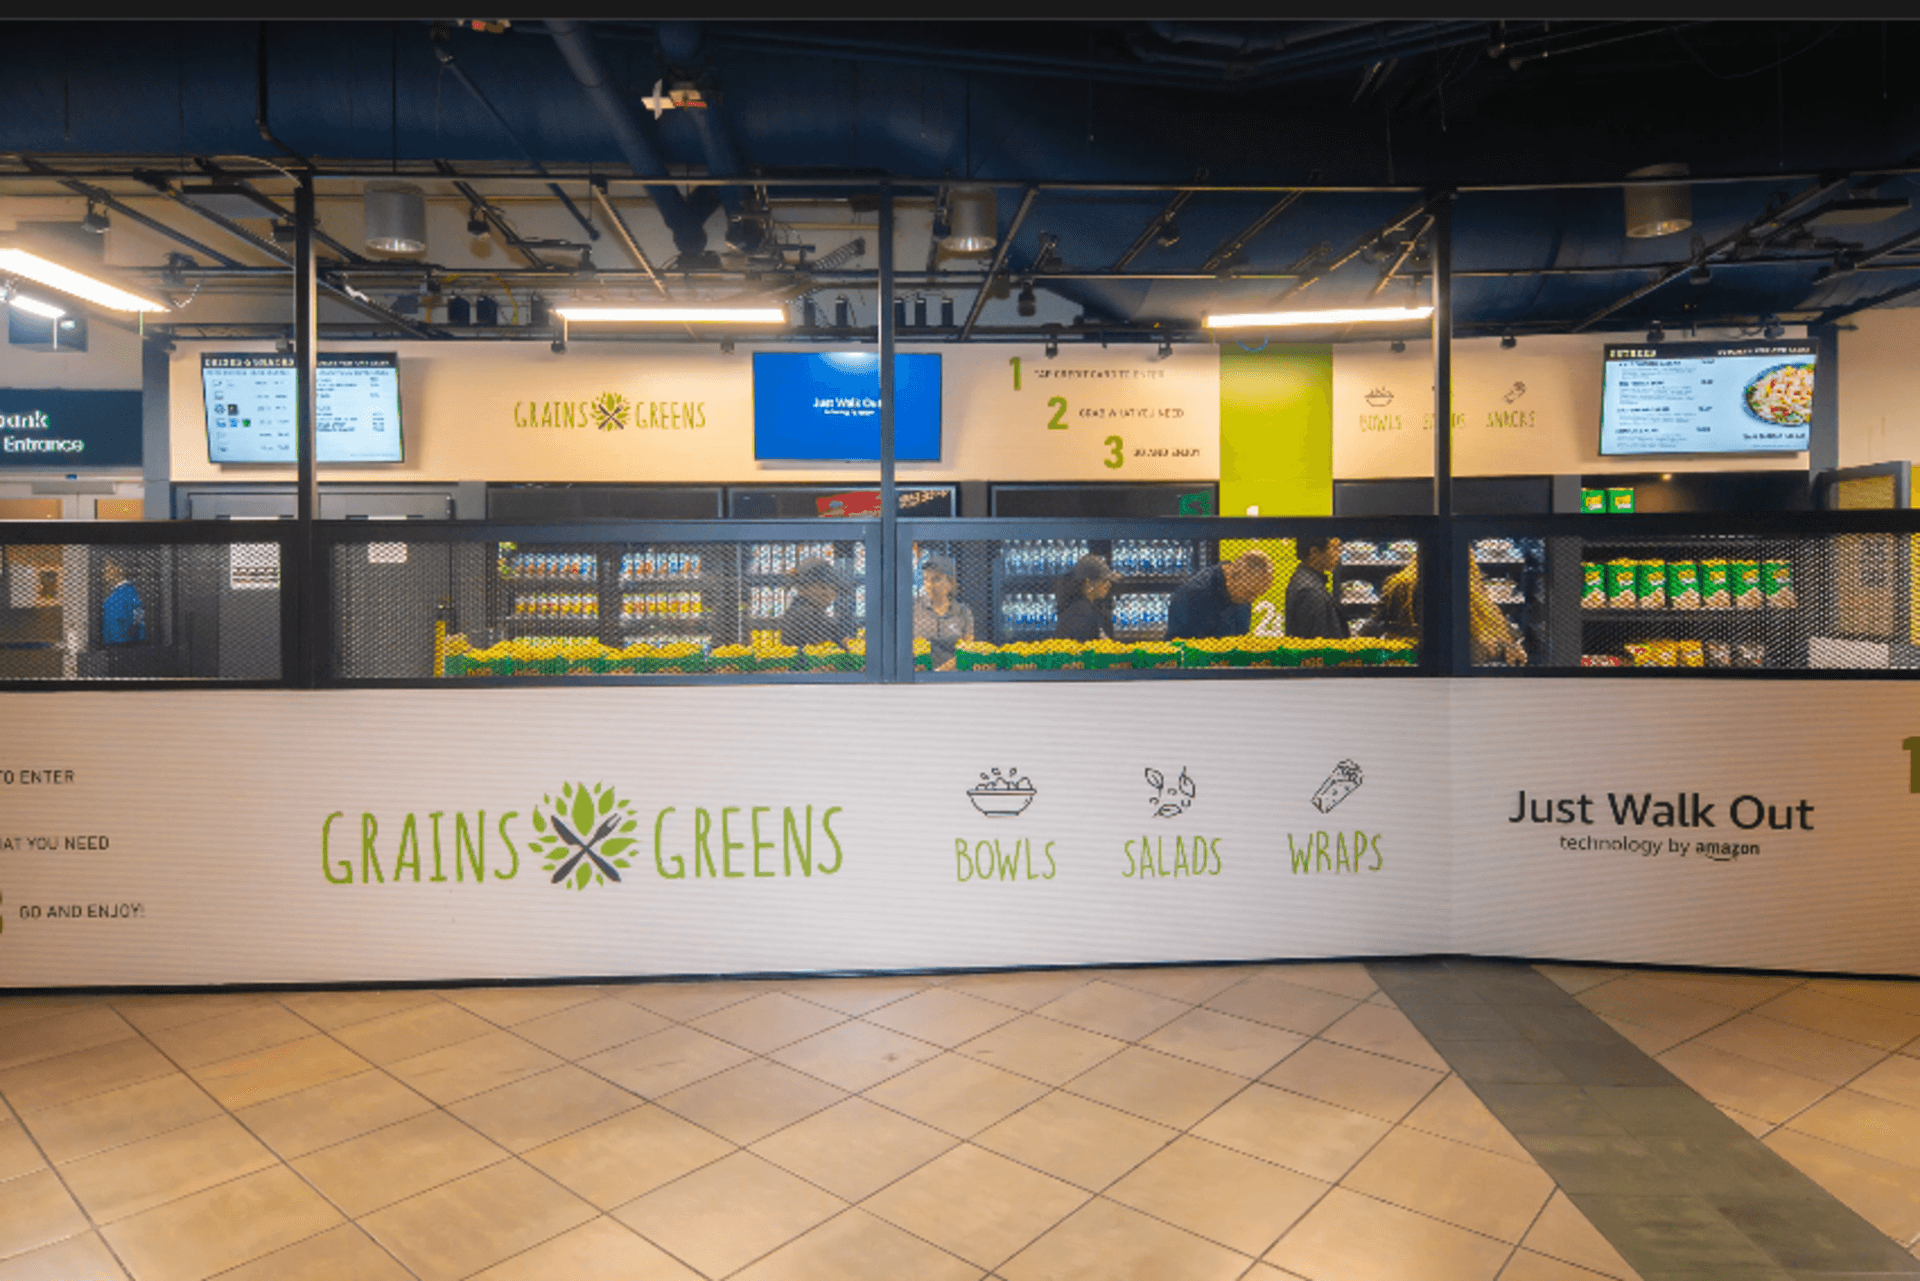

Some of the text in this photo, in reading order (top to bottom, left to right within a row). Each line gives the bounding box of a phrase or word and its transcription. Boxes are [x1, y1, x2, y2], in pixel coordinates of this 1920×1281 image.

[1010, 356, 1022, 391] 1
[514, 401, 707, 430] GRAINS GREENS
[1047, 395, 1069, 430] 2
[1359, 413, 1402, 432] BOWLS
[1486, 410, 1536, 428] SNACKS
[3, 435, 86, 453] Entrance
[1103, 434, 1125, 470] 3
[20, 769, 75, 785] ENTER
[1507, 789, 1816, 831] Just Walk Out
[26, 837, 59, 851] YOU
[64, 835, 110, 851] NEED
[321, 804, 843, 884] GRAINS GREENS
[954, 836, 1057, 882] BOWLS
[1121, 835, 1223, 879] SALADS
[1286, 830, 1383, 875] WRAPS
[1559, 835, 1762, 857] technology by amazon
[19, 904, 42, 919] GO
[47, 904, 83, 919] AND
